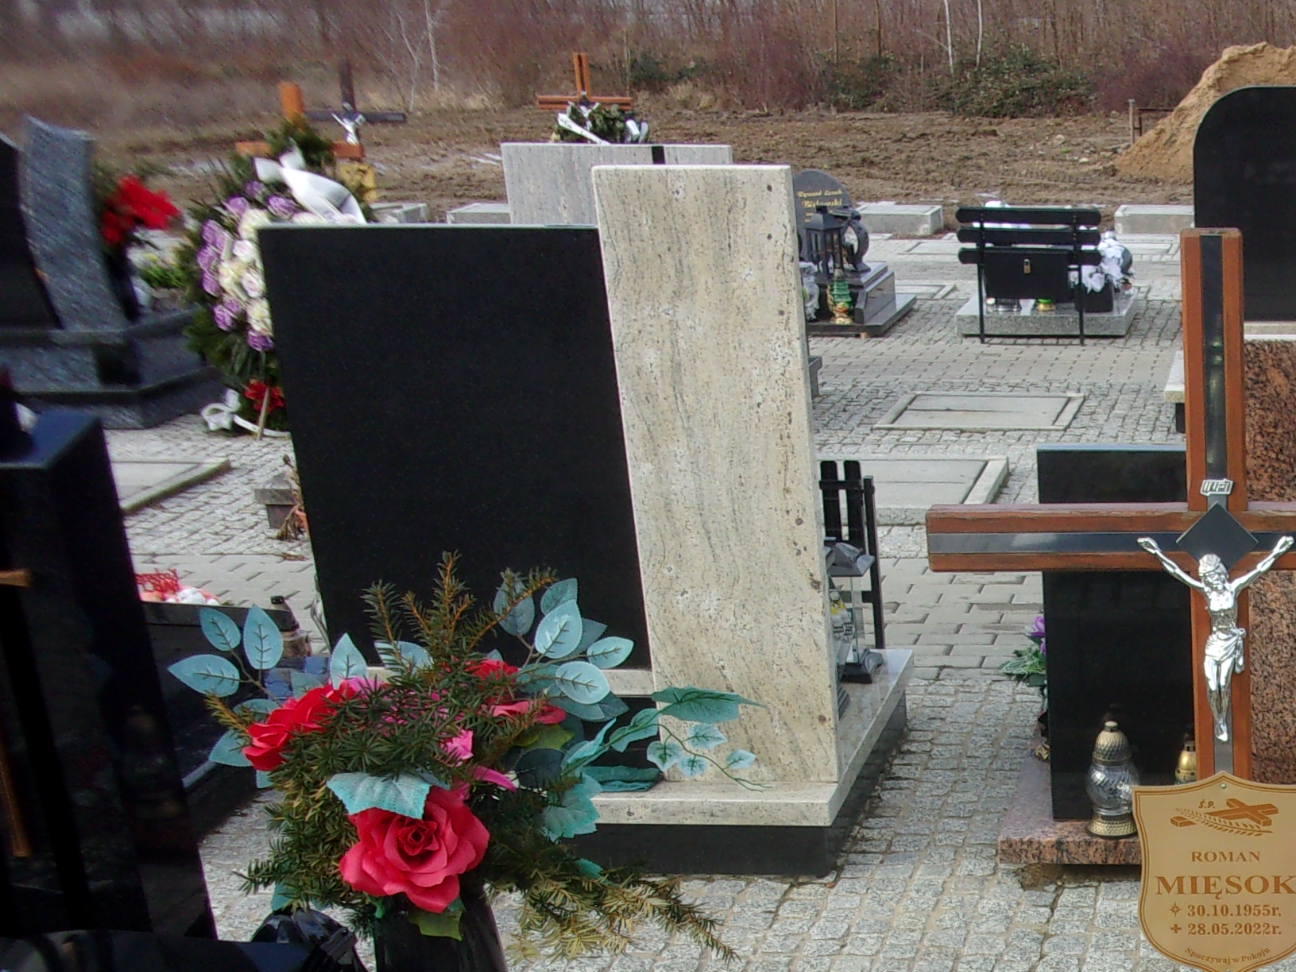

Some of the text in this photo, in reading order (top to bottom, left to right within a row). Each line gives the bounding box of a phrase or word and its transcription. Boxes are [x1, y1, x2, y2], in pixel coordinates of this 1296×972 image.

[1191, 850, 1261, 864] ROMAN
[1155, 875, 1296, 900] MIĘSOK
[1187, 903, 1283, 918] 30.10.1955r.
[1187, 922, 1283, 936] 28.05.2022r.
